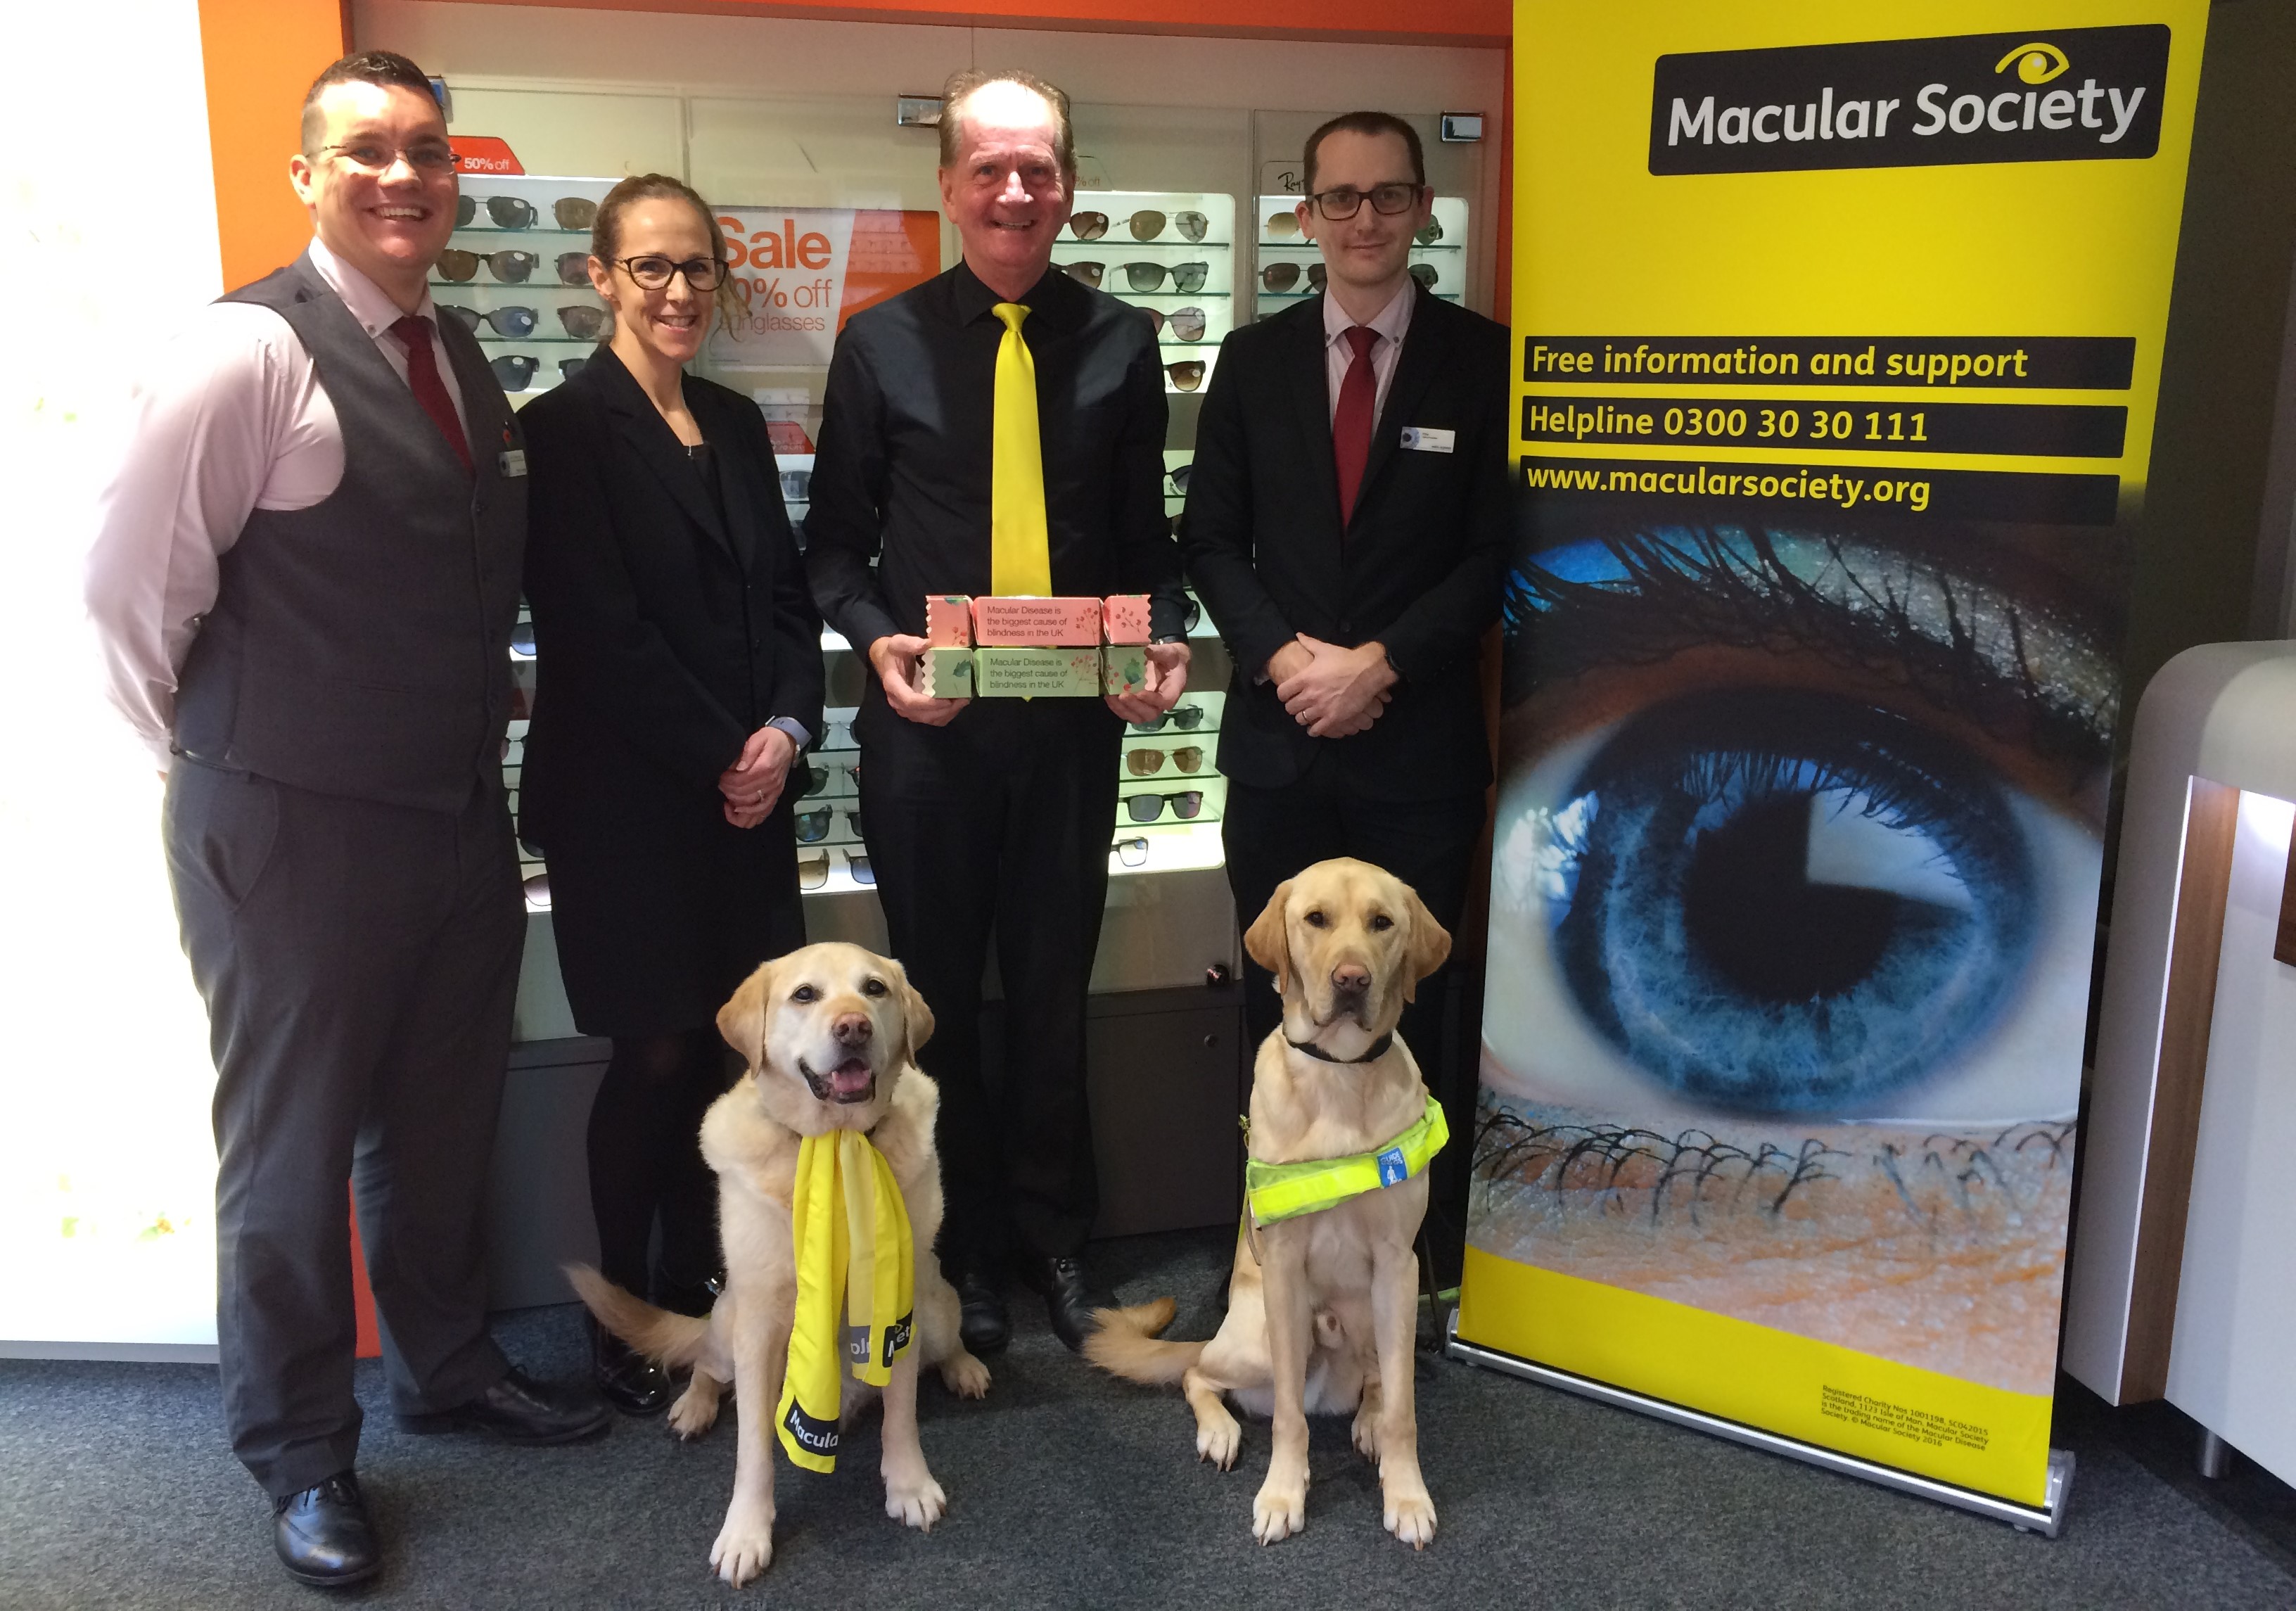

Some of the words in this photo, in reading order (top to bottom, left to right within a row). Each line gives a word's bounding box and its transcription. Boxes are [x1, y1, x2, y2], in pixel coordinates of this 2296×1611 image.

[1668, 87, 1900, 146] Macular
[1912, 79, 2146, 144] Society
[464, 158, 494, 170] 50%
[495, 159, 510, 170] off
[716, 216, 832, 270] Sale
[734, 277, 788, 308] 0%
[793, 279, 833, 308] off
[722, 312, 825, 335] nglasses
[1533, 345, 1594, 373] Free
[1605, 344, 1799, 374] information
[1810, 345, 1875, 376] and
[1886, 349, 2029, 381] support
[1531, 405, 1654, 440] Helpline
[1664, 407, 1747, 437] 0300
[1757, 409, 1799, 438] 30
[1809, 410, 1853, 440] 30
[1864, 412, 1928, 441] 111
[1527, 466, 1931, 512] www.macularsociety.org
[987, 606, 1019, 614] Macular
[1021, 606, 1053, 614] Disease
[1054, 606, 1061, 614] is
[1002, 618, 1031, 628] biggest
[990, 658, 1021, 666] Macular
[1023, 658, 1054, 666] Disease
[1005, 670, 1033, 679] biggest
[1059, 669, 1069, 677] of
[990, 680, 1027, 689] blindness
[1052, 680, 1064, 689] UK
[1823, 1384, 1862, 1401] Registered
[1864, 1396, 1892, 1410] Charity
[1893, 1405, 1908, 1415] Nos
[1830, 1402, 1842, 1411] the
[1844, 1406, 1871, 1420] trading
[1873, 1415, 1895, 1426] name
[1907, 1424, 1920, 1433] the
[1922, 1427, 1953, 1441] Macular
[1956, 1437, 1986, 1451] Disease
[1859, 1403, 1878, 1413] 1123
[1880, 1409, 1894, 1418] Isle
[1927, 1421, 1958, 1435] Macular
[1960, 1430, 1989, 1445] Society
[1861, 1418, 1891, 1432] Macular
[1893, 1427, 1920, 1442] Society
[1922, 1436, 1943, 1447] 2016
